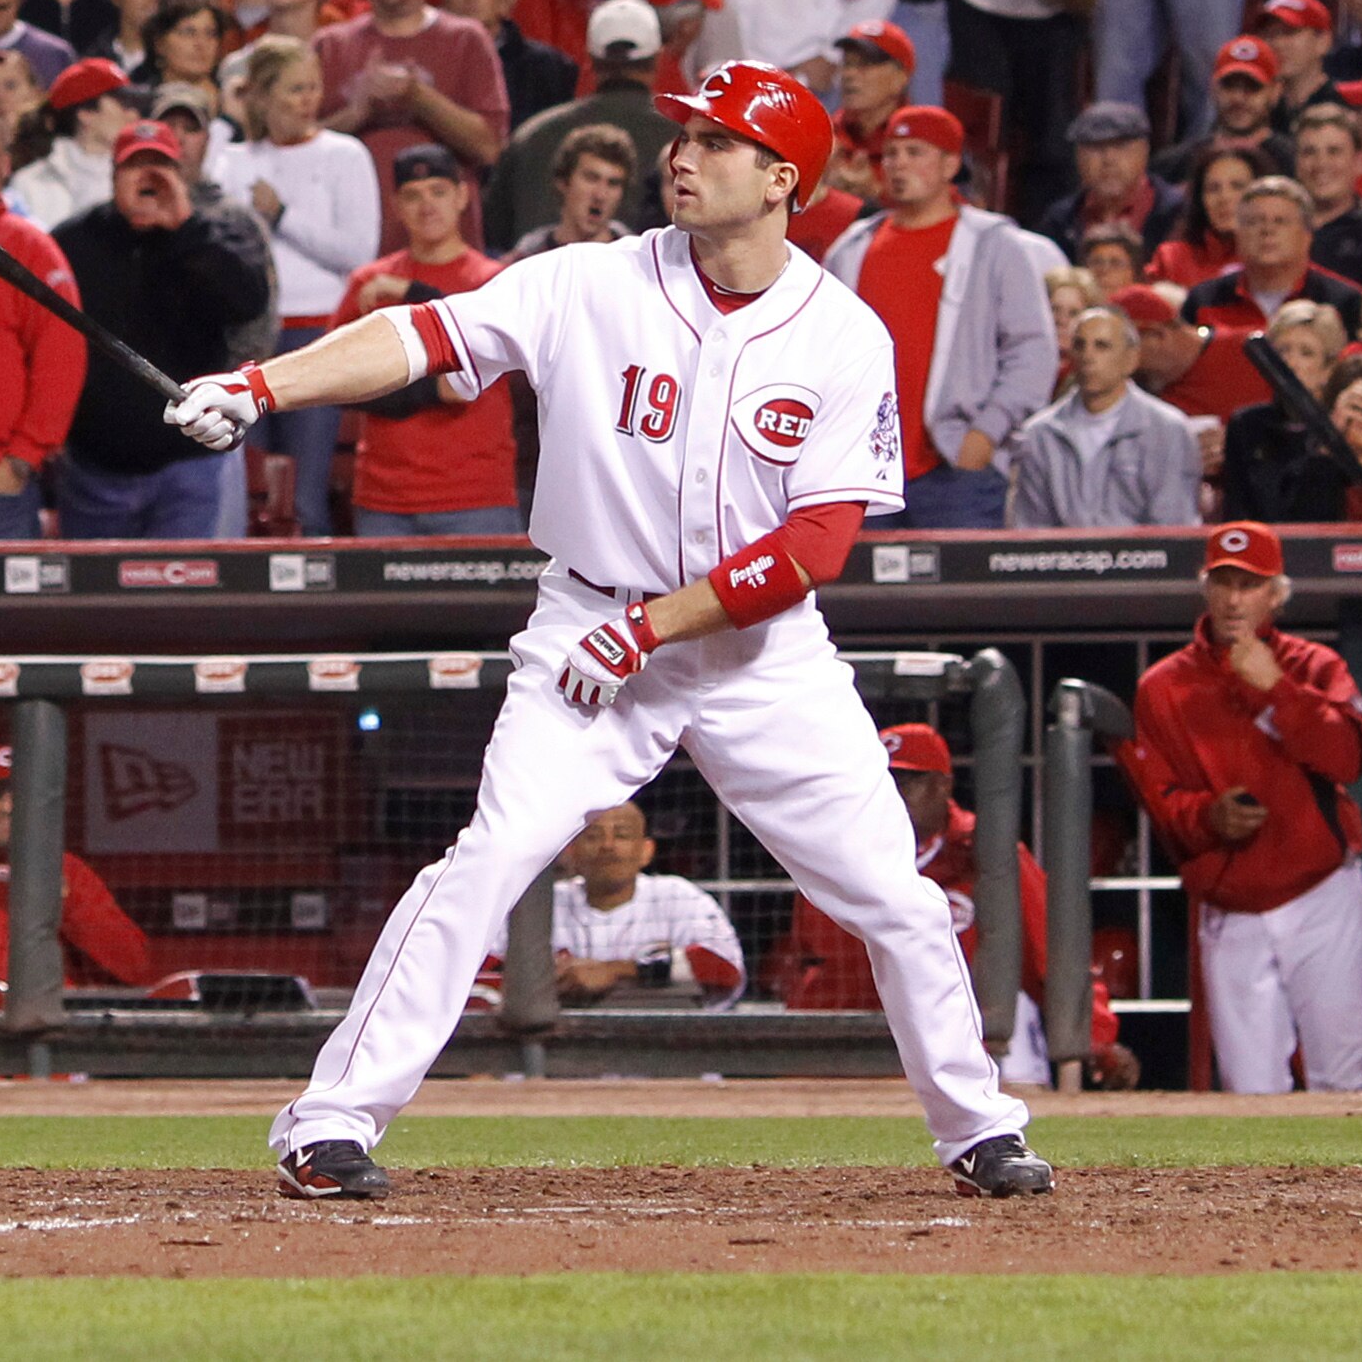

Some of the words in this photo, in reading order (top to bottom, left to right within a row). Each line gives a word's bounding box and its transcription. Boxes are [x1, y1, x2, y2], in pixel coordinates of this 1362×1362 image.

[700, 70, 732, 98] C
[615, 364, 682, 444] 19
[990, 550, 1167, 572] neweracap.com
[747, 573, 766, 589] 19
[233, 742, 324, 779] NEW
[232, 783, 323, 823] ERA
